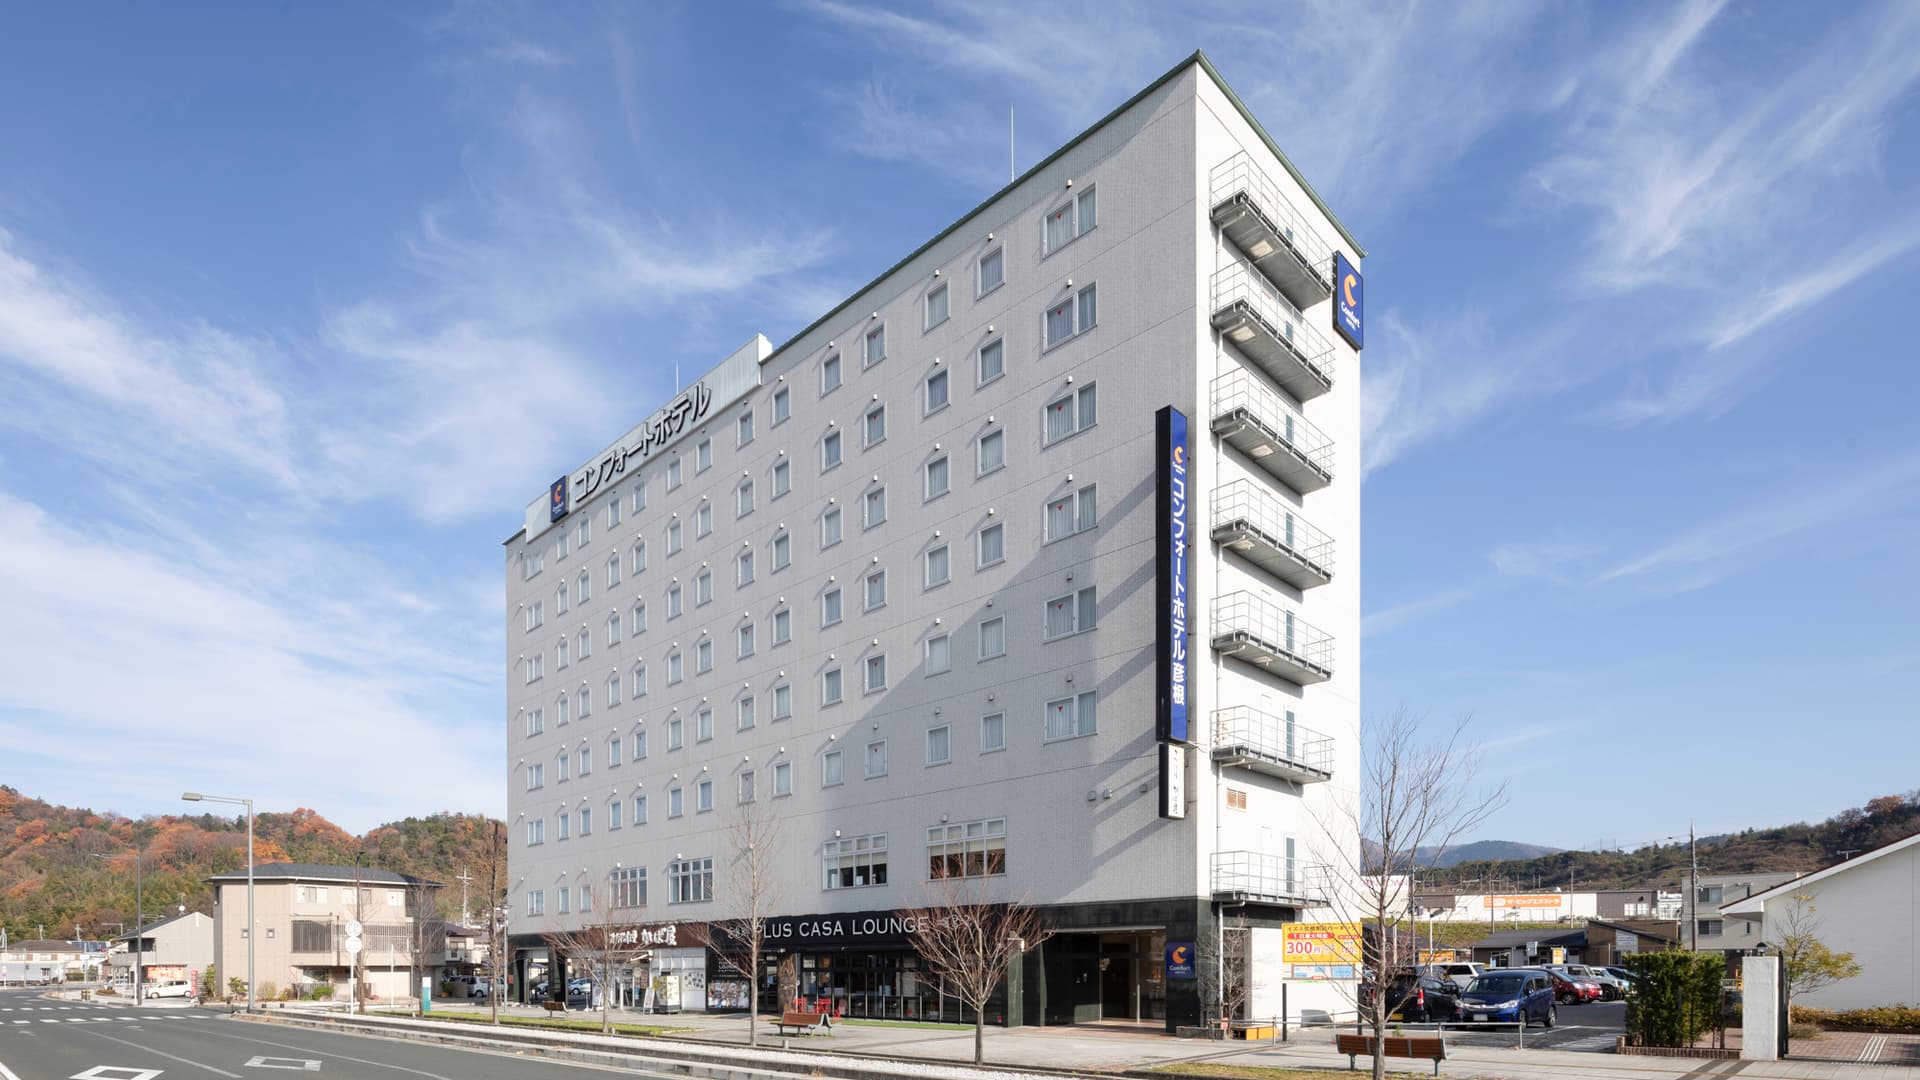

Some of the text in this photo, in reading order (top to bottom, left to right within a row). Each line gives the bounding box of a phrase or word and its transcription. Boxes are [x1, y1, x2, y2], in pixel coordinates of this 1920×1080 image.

[575, 381, 712, 503] コンフォートホテル
[1173, 478, 1186, 706] コンフォートホテル彦根
[799, 920, 844, 937] CASA
[852, 916, 930, 935] LOUNGE
